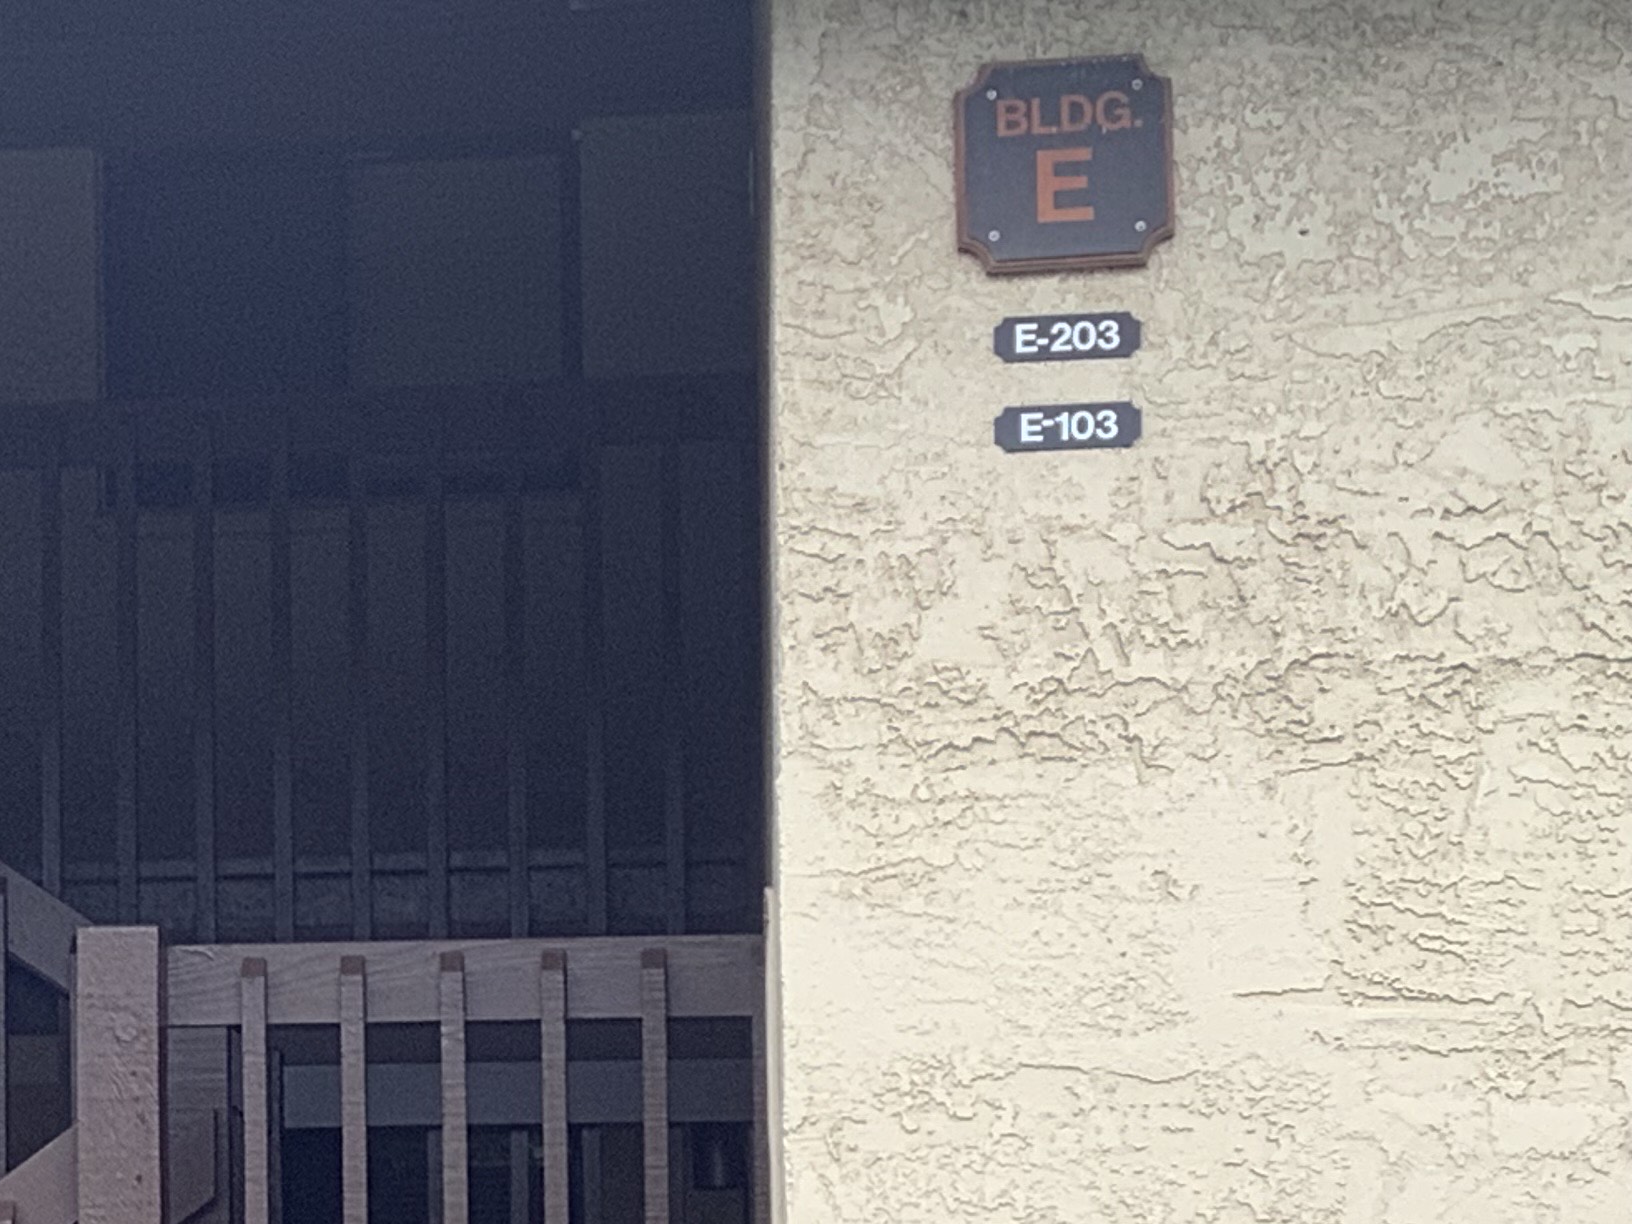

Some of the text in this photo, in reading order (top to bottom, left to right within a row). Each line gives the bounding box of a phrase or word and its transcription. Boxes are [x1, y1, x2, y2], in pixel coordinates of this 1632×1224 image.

[996, 90, 1144, 137] BLDG.
[1035, 146, 1095, 223] E
[1015, 319, 1121, 353] E-203
[1020, 409, 1119, 442] E-103
